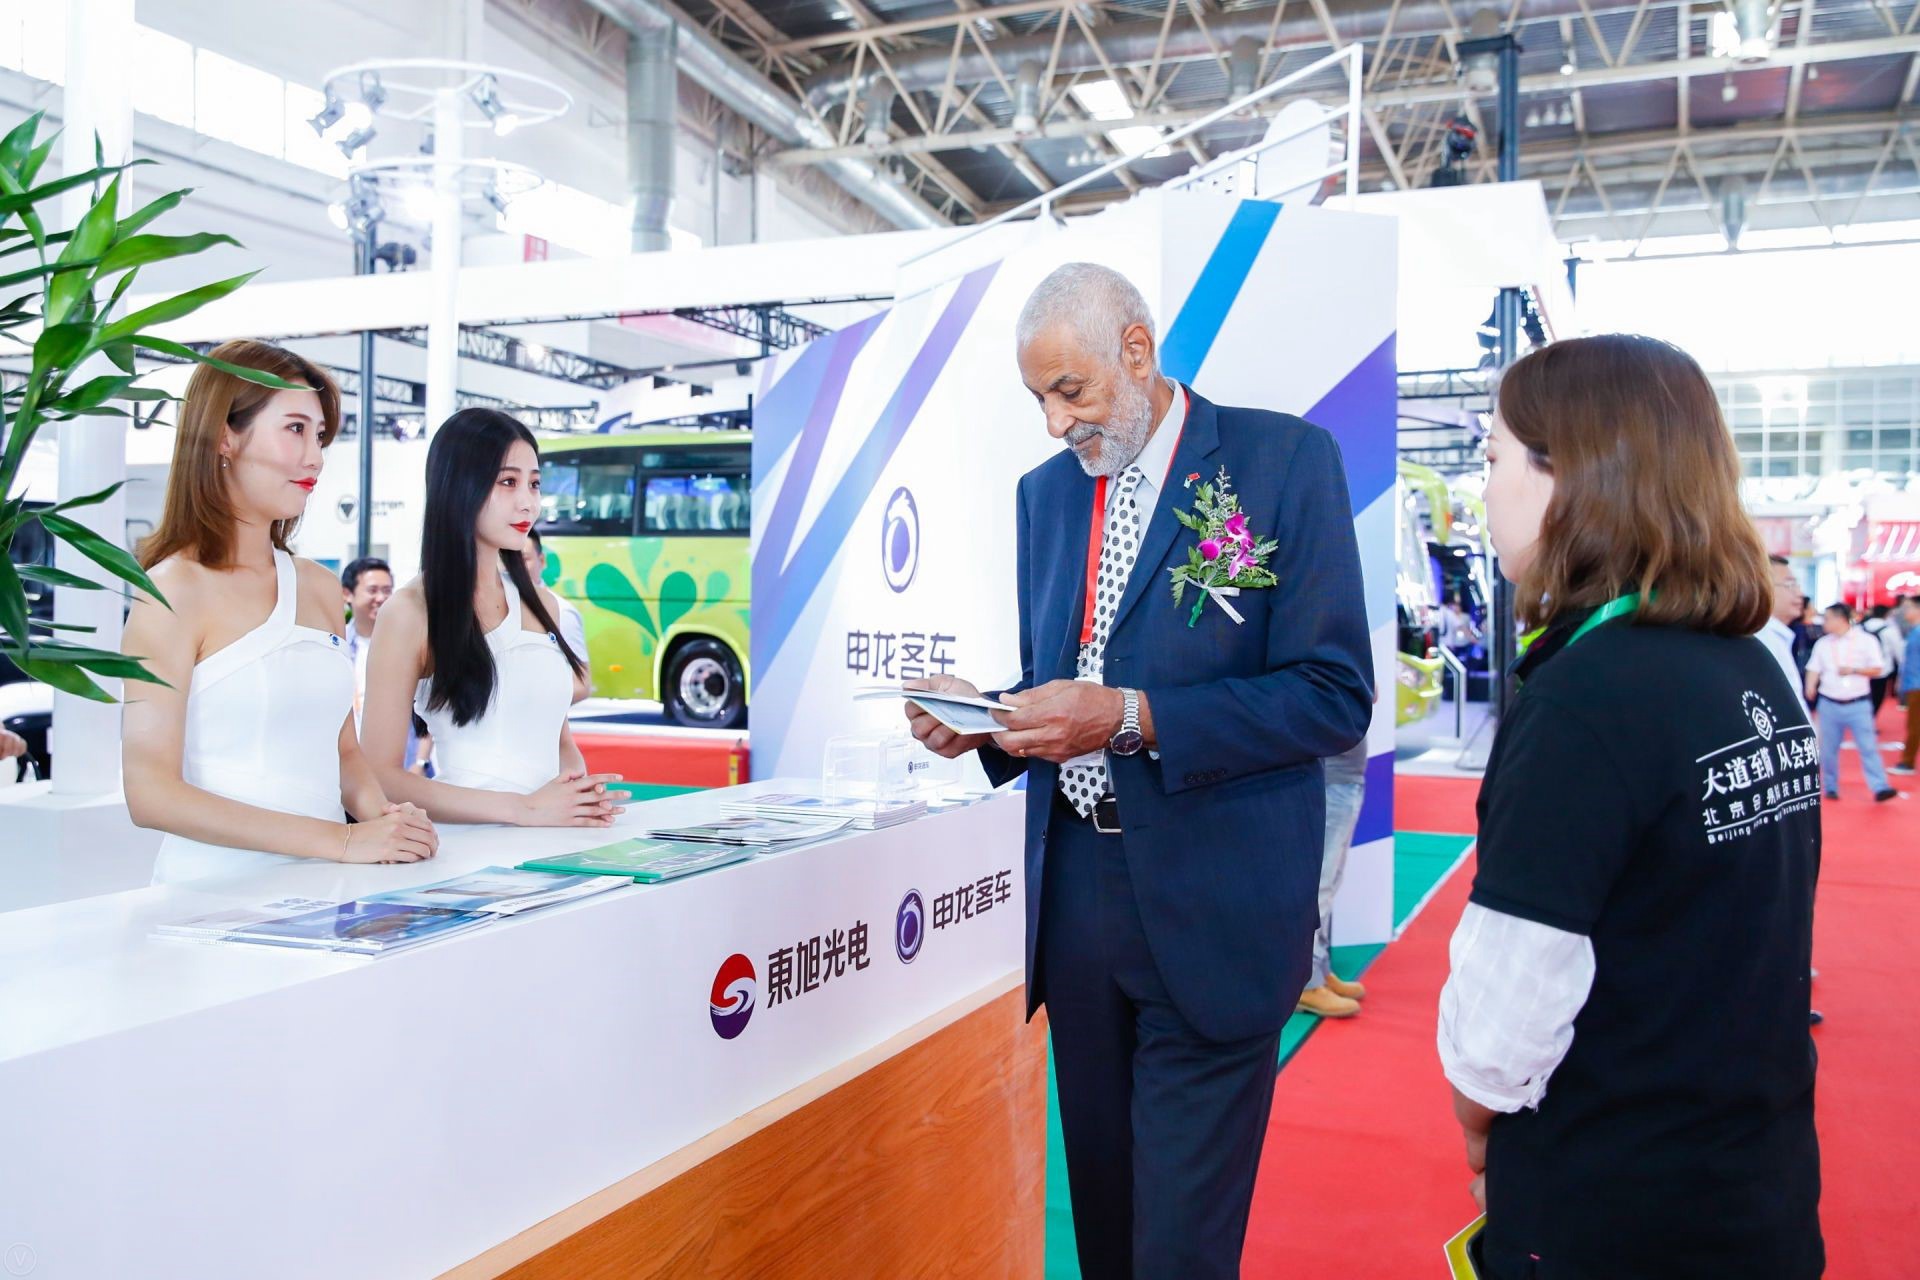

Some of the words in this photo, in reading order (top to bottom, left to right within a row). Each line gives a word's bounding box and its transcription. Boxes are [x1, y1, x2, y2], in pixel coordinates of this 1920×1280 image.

[847, 629, 956, 680] 申龙客车
[1707, 825, 1751, 845] Beijing
[932, 869, 1012, 930] 申龙客车
[767, 920, 871, 1009] 東旭光电
